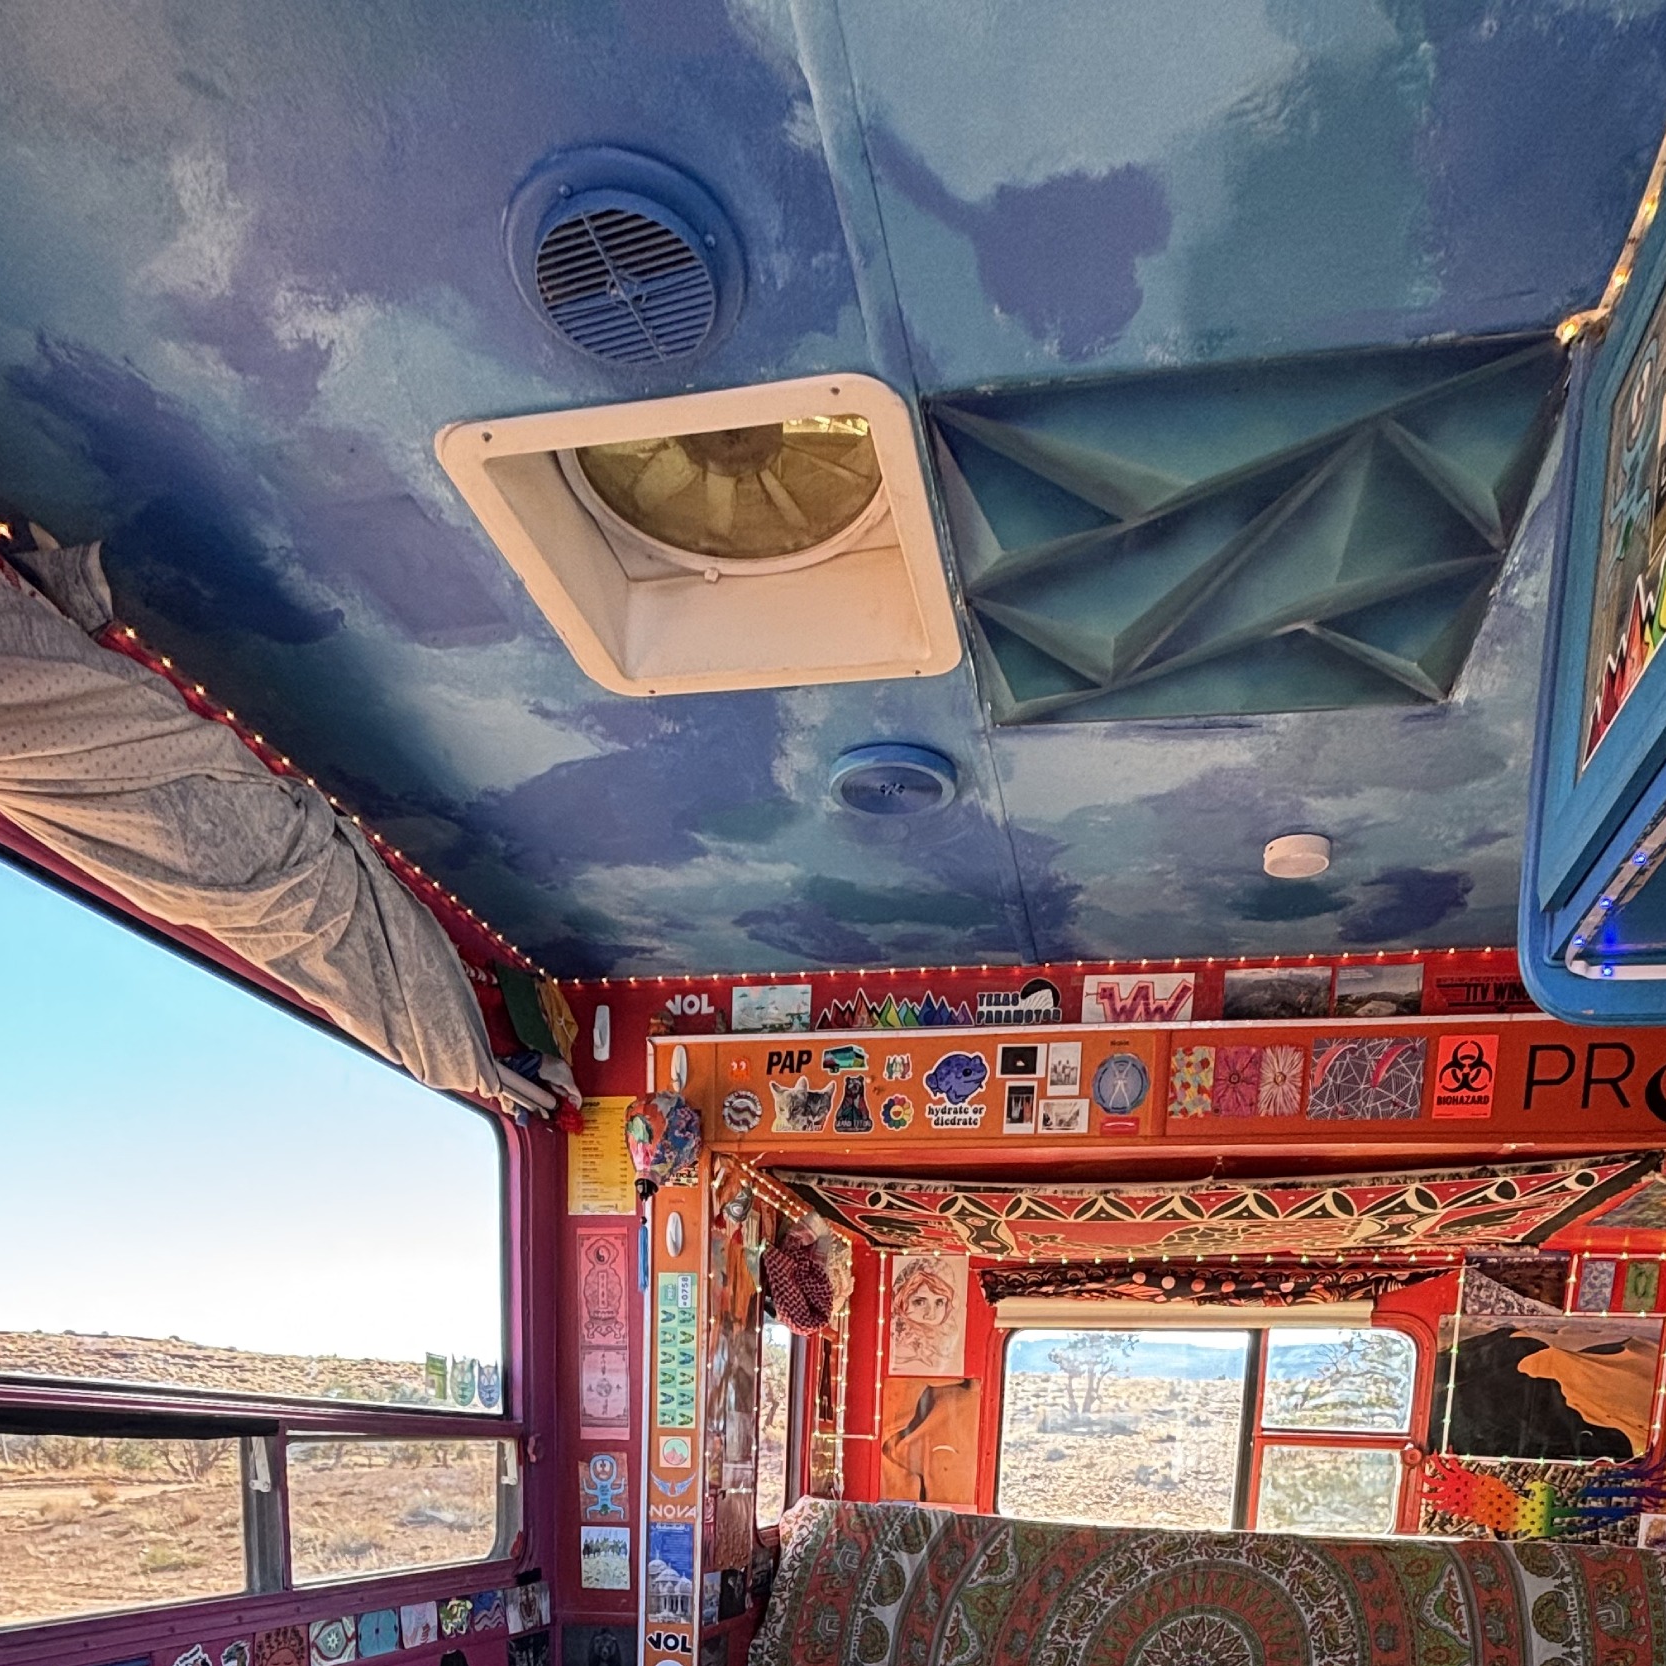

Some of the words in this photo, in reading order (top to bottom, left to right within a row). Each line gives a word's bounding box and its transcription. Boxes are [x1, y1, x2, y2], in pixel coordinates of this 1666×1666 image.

[665, 993, 715, 1015] VOL
[978, 992, 1020, 1006] TEXAS
[976, 1009, 1061, 1024] PARAMOTOR
[766, 1050, 813, 1075] PAP
[1436, 1095, 1490, 1106] BIOHAZARD
[927, 1105, 969, 1116] hydrate
[972, 1107, 984, 1115] or
[933, 1116, 979, 1126] diedrate
[649, 1504, 696, 1519] NOVA
[647, 1632, 692, 1653] VOL
